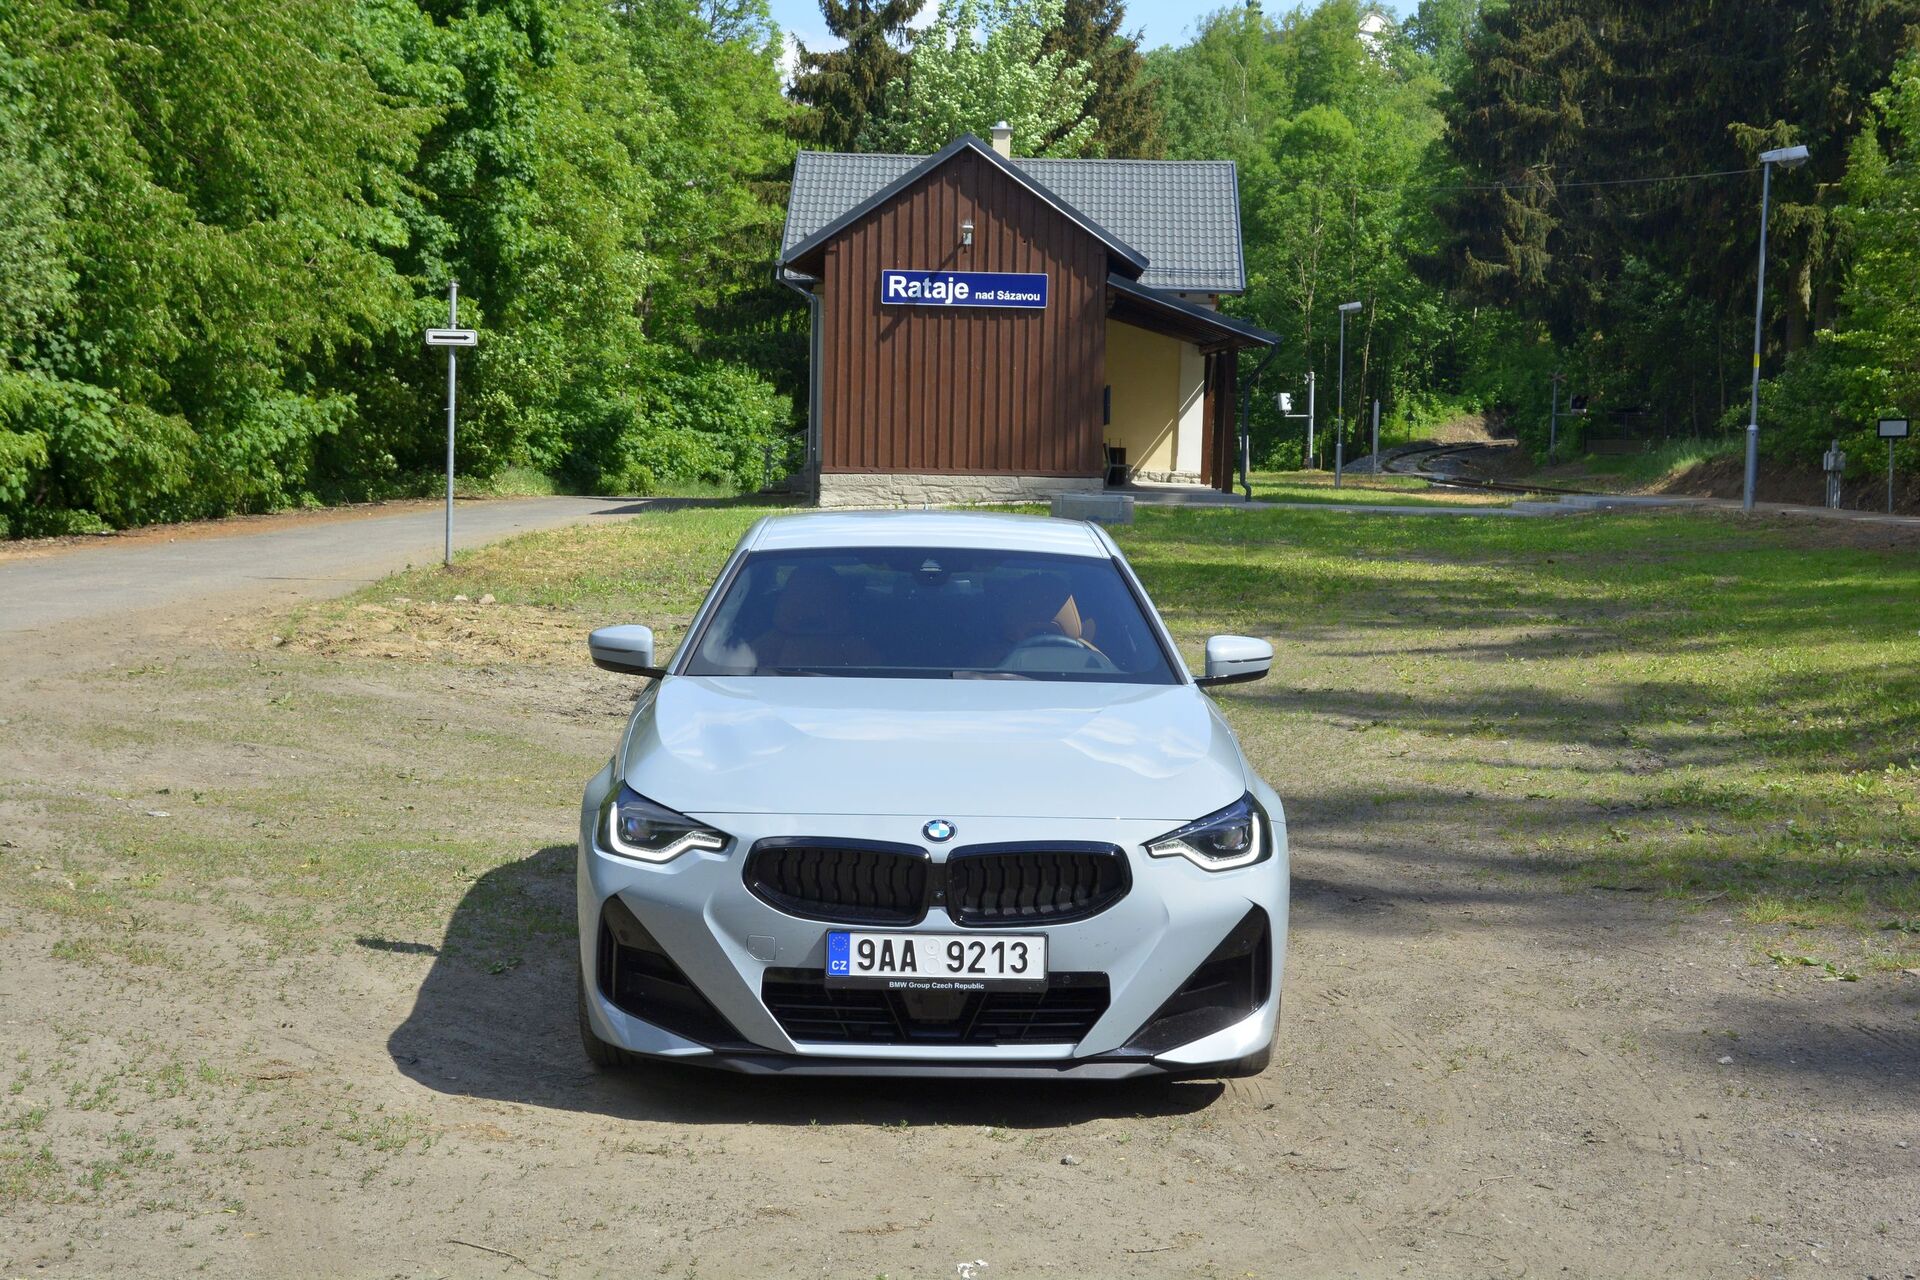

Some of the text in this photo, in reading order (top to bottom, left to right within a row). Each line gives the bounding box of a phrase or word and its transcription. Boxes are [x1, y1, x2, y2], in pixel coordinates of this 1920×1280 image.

[888, 275, 1041, 304] Rataje nad Sázavou
[831, 960, 847, 970] CZ
[857, 939, 1028, 974] 9AA 9213
[908, 981, 930, 989] Group
[954, 982, 985, 990] Republic
